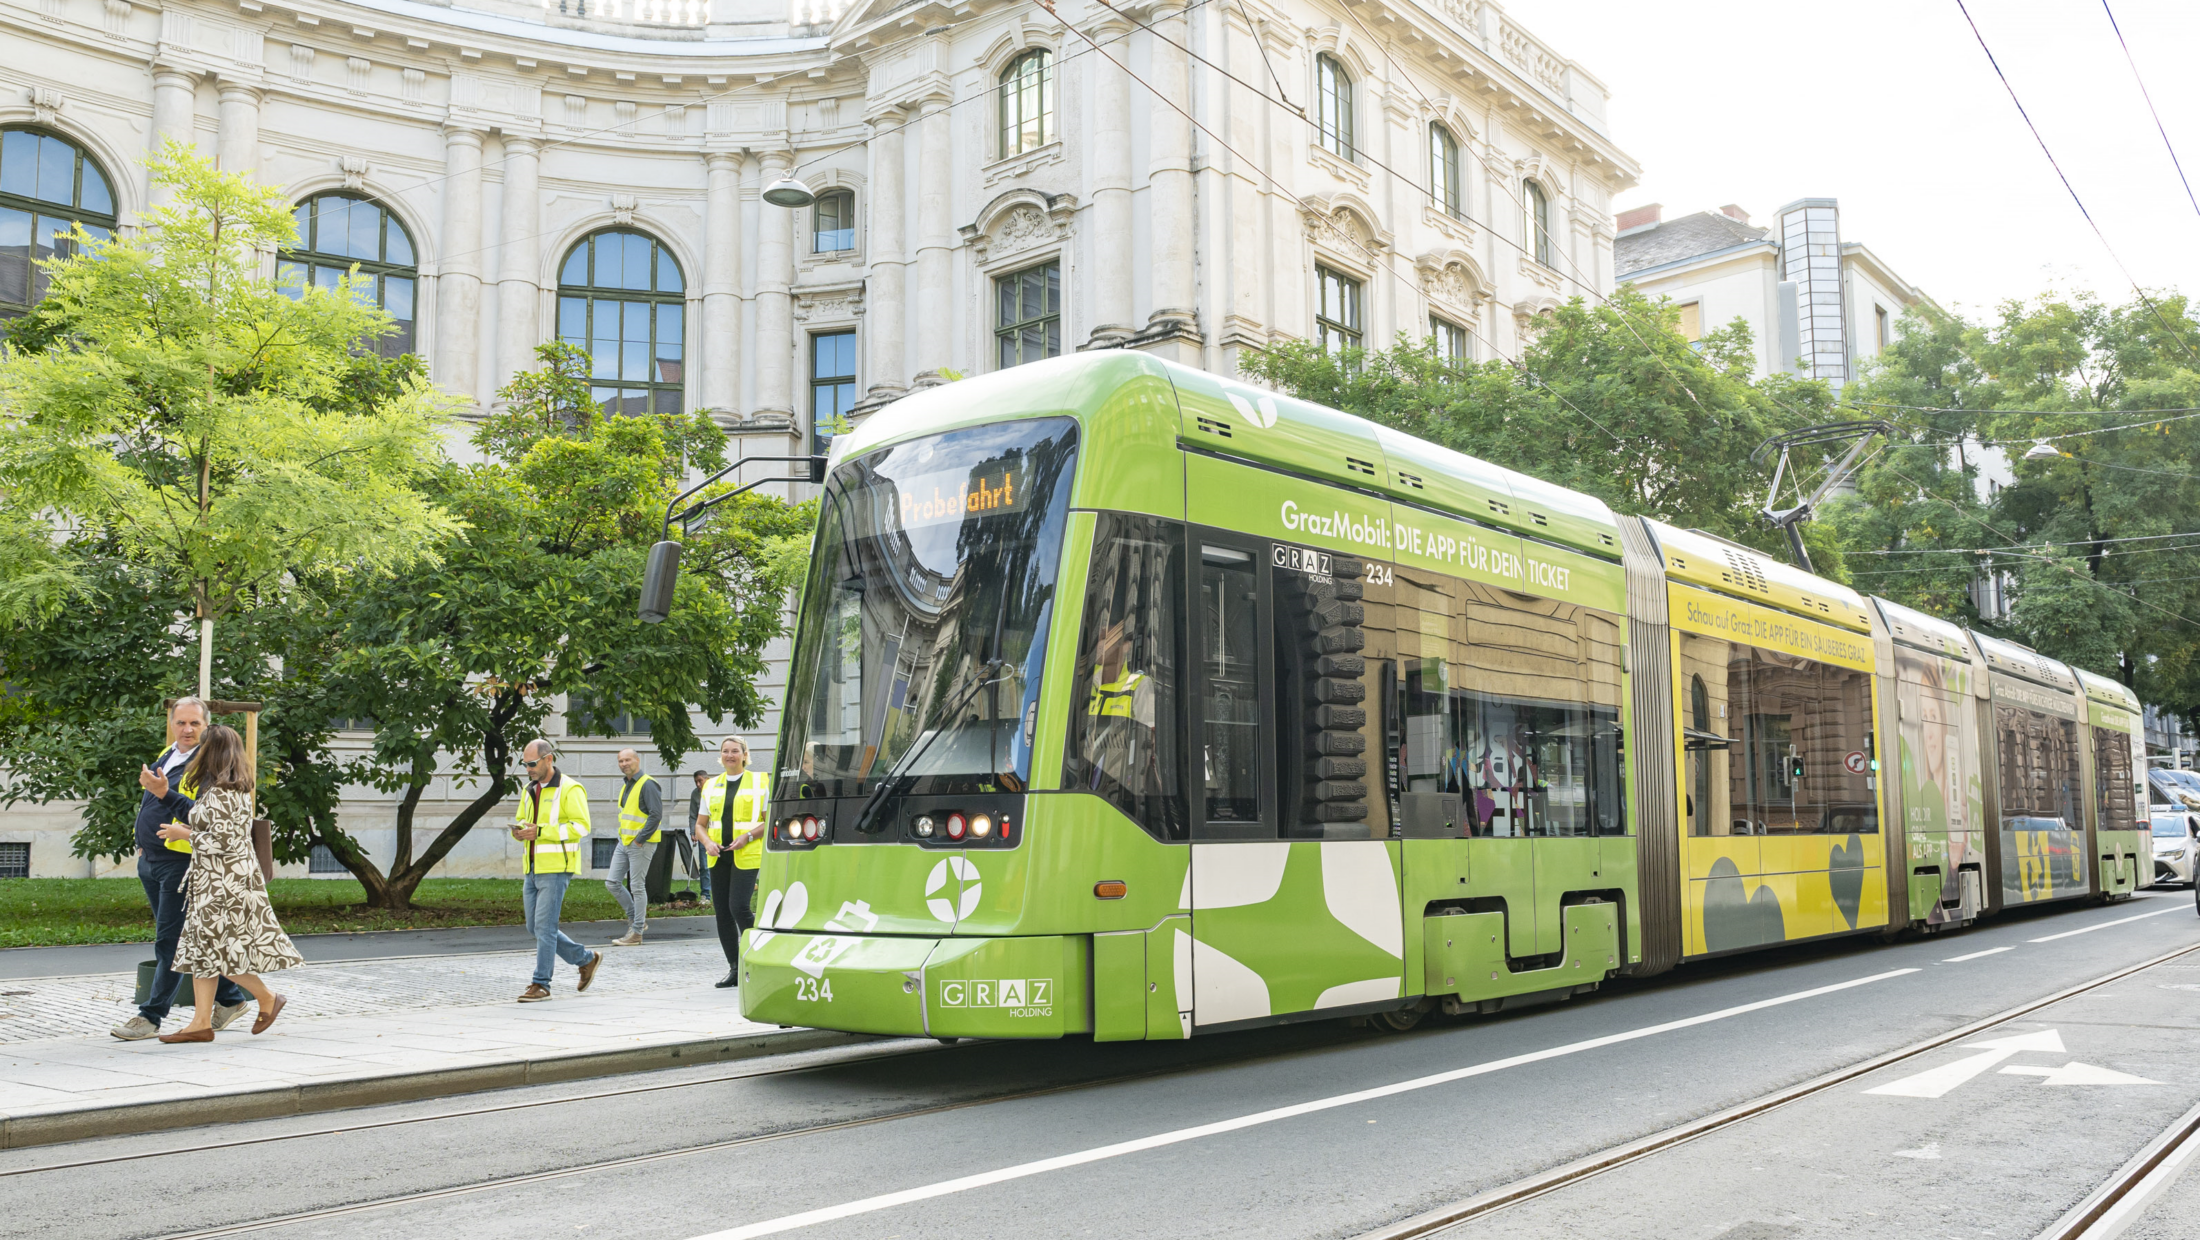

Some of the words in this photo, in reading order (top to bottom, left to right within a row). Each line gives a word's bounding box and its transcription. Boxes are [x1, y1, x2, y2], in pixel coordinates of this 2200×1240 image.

[901, 473, 1013, 524] Probefahrt
[1273, 544, 1331, 575] GRAZ
[1281, 500, 1391, 549] GrazMobil:
[1395, 523, 1422, 555] DIE
[1426, 532, 1456, 563] APP
[1459, 536, 1489, 572] FÜR
[1491, 549, 1525, 580] DEIN
[1528, 558, 1570, 592] TICKET
[1308, 574, 1333, 585] HOLDING
[1366, 563, 1394, 588] 234
[1687, 601, 1714, 627] Schau
[1715, 610, 1729, 631] auf
[1730, 613, 1754, 637] Graz:
[1754, 619, 1768, 640] DIE
[1768, 623, 1784, 643] APP
[1785, 623, 1799, 647] FÜR
[1800, 631, 1813, 651] EIN
[1813, 634, 1847, 659] SAUBERES
[1847, 643, 1866, 663] GRAZ
[1910, 806, 1922, 822] HOL
[1912, 843, 1923, 859] ALS
[1923, 843, 1933, 859] APP
[794, 976, 834, 1003] 234
[941, 980, 1051, 1007] GRAZ
[1009, 1007, 1053, 1018] HOLDING
